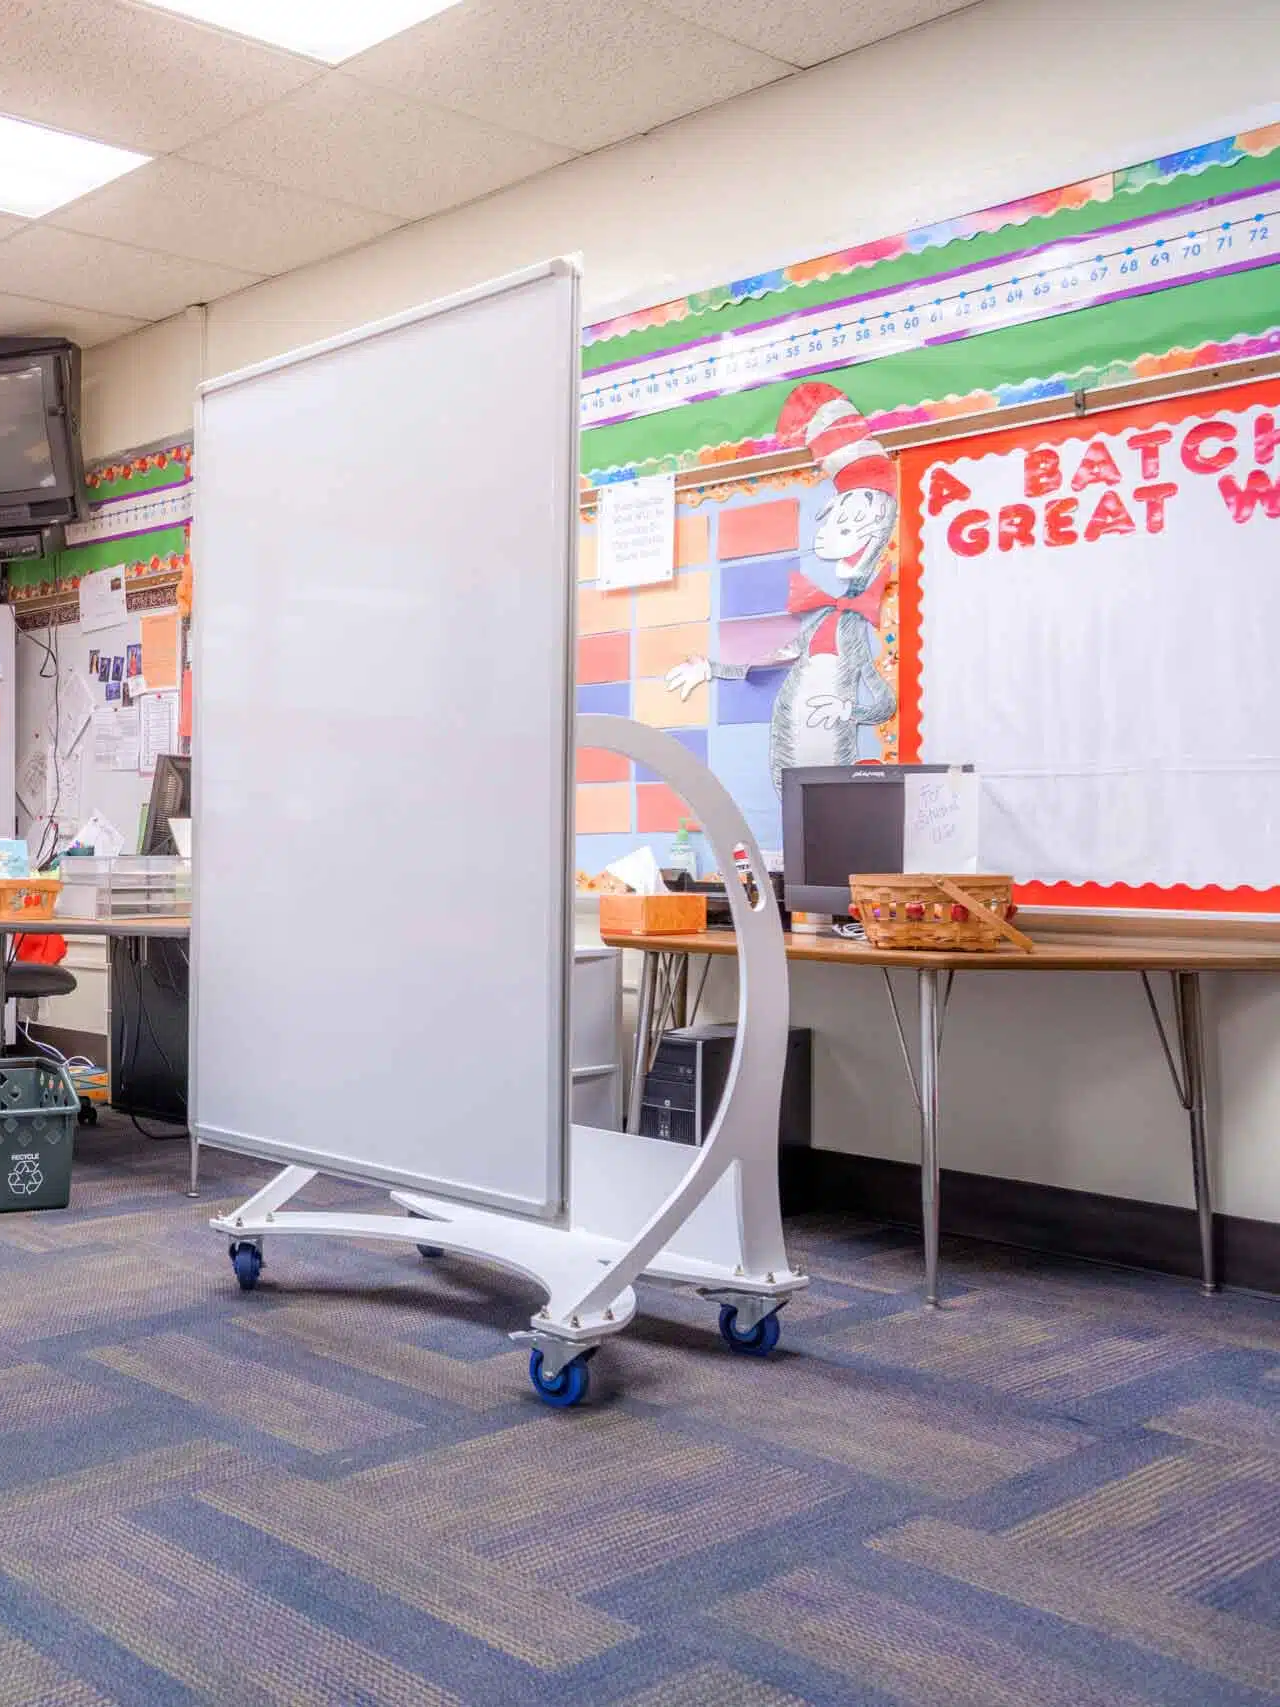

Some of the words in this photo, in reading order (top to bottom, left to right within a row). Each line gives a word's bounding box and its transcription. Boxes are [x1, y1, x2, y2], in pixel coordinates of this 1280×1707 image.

[592, 398, 605, 409] 45
[627, 388, 641, 400] 47
[665, 377, 680, 389] 49
[704, 368, 718, 380] 51
[765, 351, 780, 364] 54
[786, 345, 801, 358] 55
[808, 340, 824, 353] 56
[831, 334, 847, 348] 57
[855, 328, 871, 342] 58
[879, 322, 896, 336] 59
[903, 316, 920, 330] 60
[929, 309, 944, 323] 61
[980, 297, 997, 310] 63
[1007, 290, 1024, 304] 64
[1033, 281, 1051, 296] 65
[1090, 266, 1109, 282] 67
[1120, 259, 1139, 274] 68
[1150, 252, 1170, 267] 69
[1182, 243, 1201, 259] 70
[1217, 236, 1233, 252] 71
[1249, 227, 1269, 242] 72
[927, 467, 971, 516] A
[947, 482, 1179, 558] GREAT
[11, 1153, 40, 1161] RECYCLE
